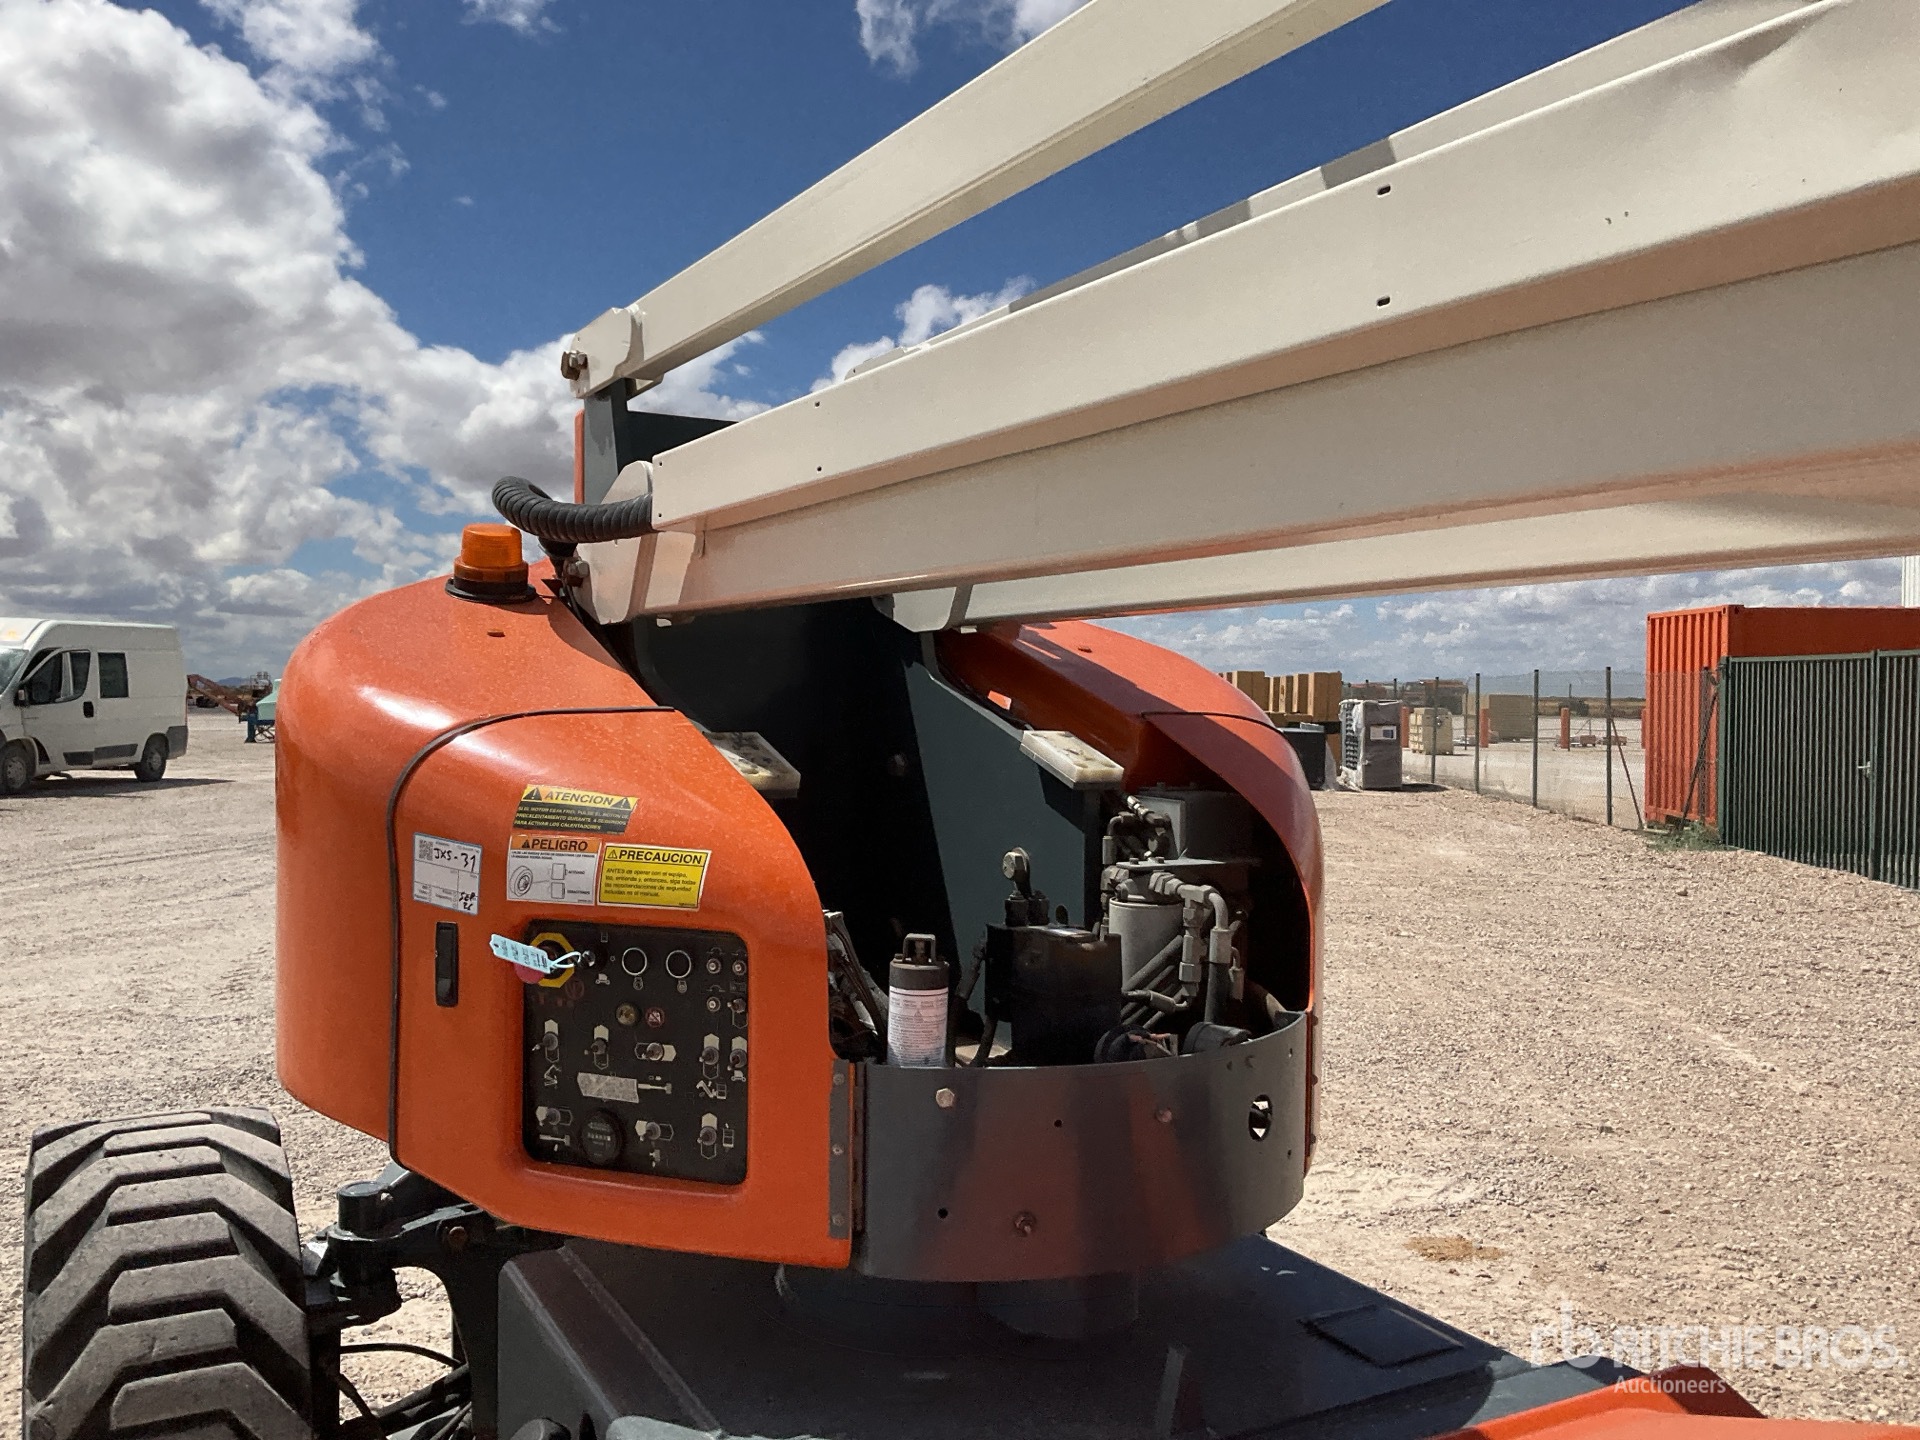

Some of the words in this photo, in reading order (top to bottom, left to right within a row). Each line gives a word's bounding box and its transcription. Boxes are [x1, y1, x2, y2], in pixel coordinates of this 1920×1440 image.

[545, 791, 614, 806] ATENCION
[531, 839, 588, 852] PELIGRO
[619, 849, 702, 865] PRECAUCION
